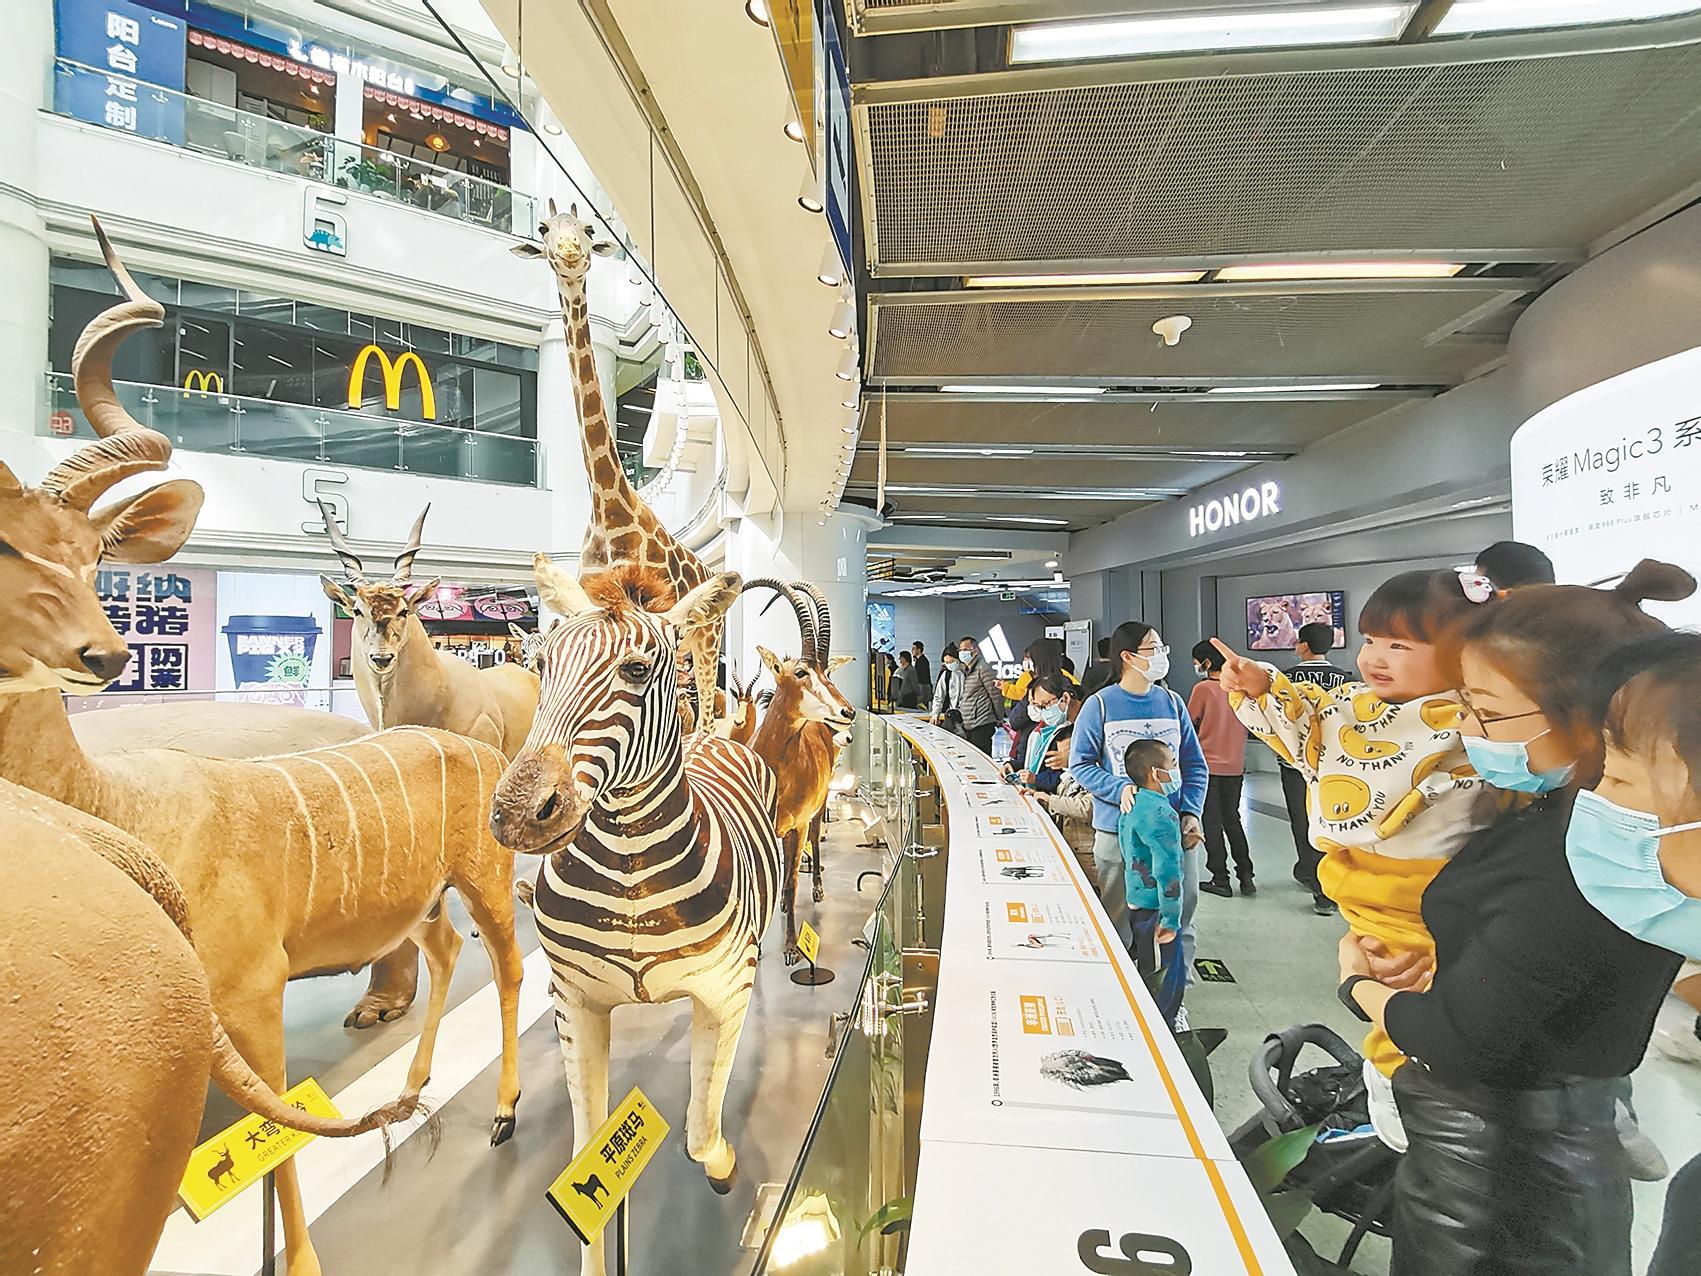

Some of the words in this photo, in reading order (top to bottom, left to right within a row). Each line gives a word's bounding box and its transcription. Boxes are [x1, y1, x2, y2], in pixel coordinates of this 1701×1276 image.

[105, 11, 140, 131] 阳台定制
[1542, 456, 1569, 487] 荣耀
[1574, 427, 1663, 475] Magic3
[1189, 481, 1281, 537] HONOR
[150, 647, 182, 688] 奶茶
[1369, 704, 1401, 733] THAN
[1430, 731, 1451, 742] NO
[1336, 754, 1355, 767] NO
[1453, 779, 1474, 790] NO
[1328, 810, 1377, 833] THANK
[1373, 790, 1387, 811] YOU
[257, 1136, 291, 1162] GREATER
[600, 1110, 645, 1165] 平原斑马
[614, 1153, 635, 1180] PLAINS
[631, 1135, 648, 1158] ZEBRA
